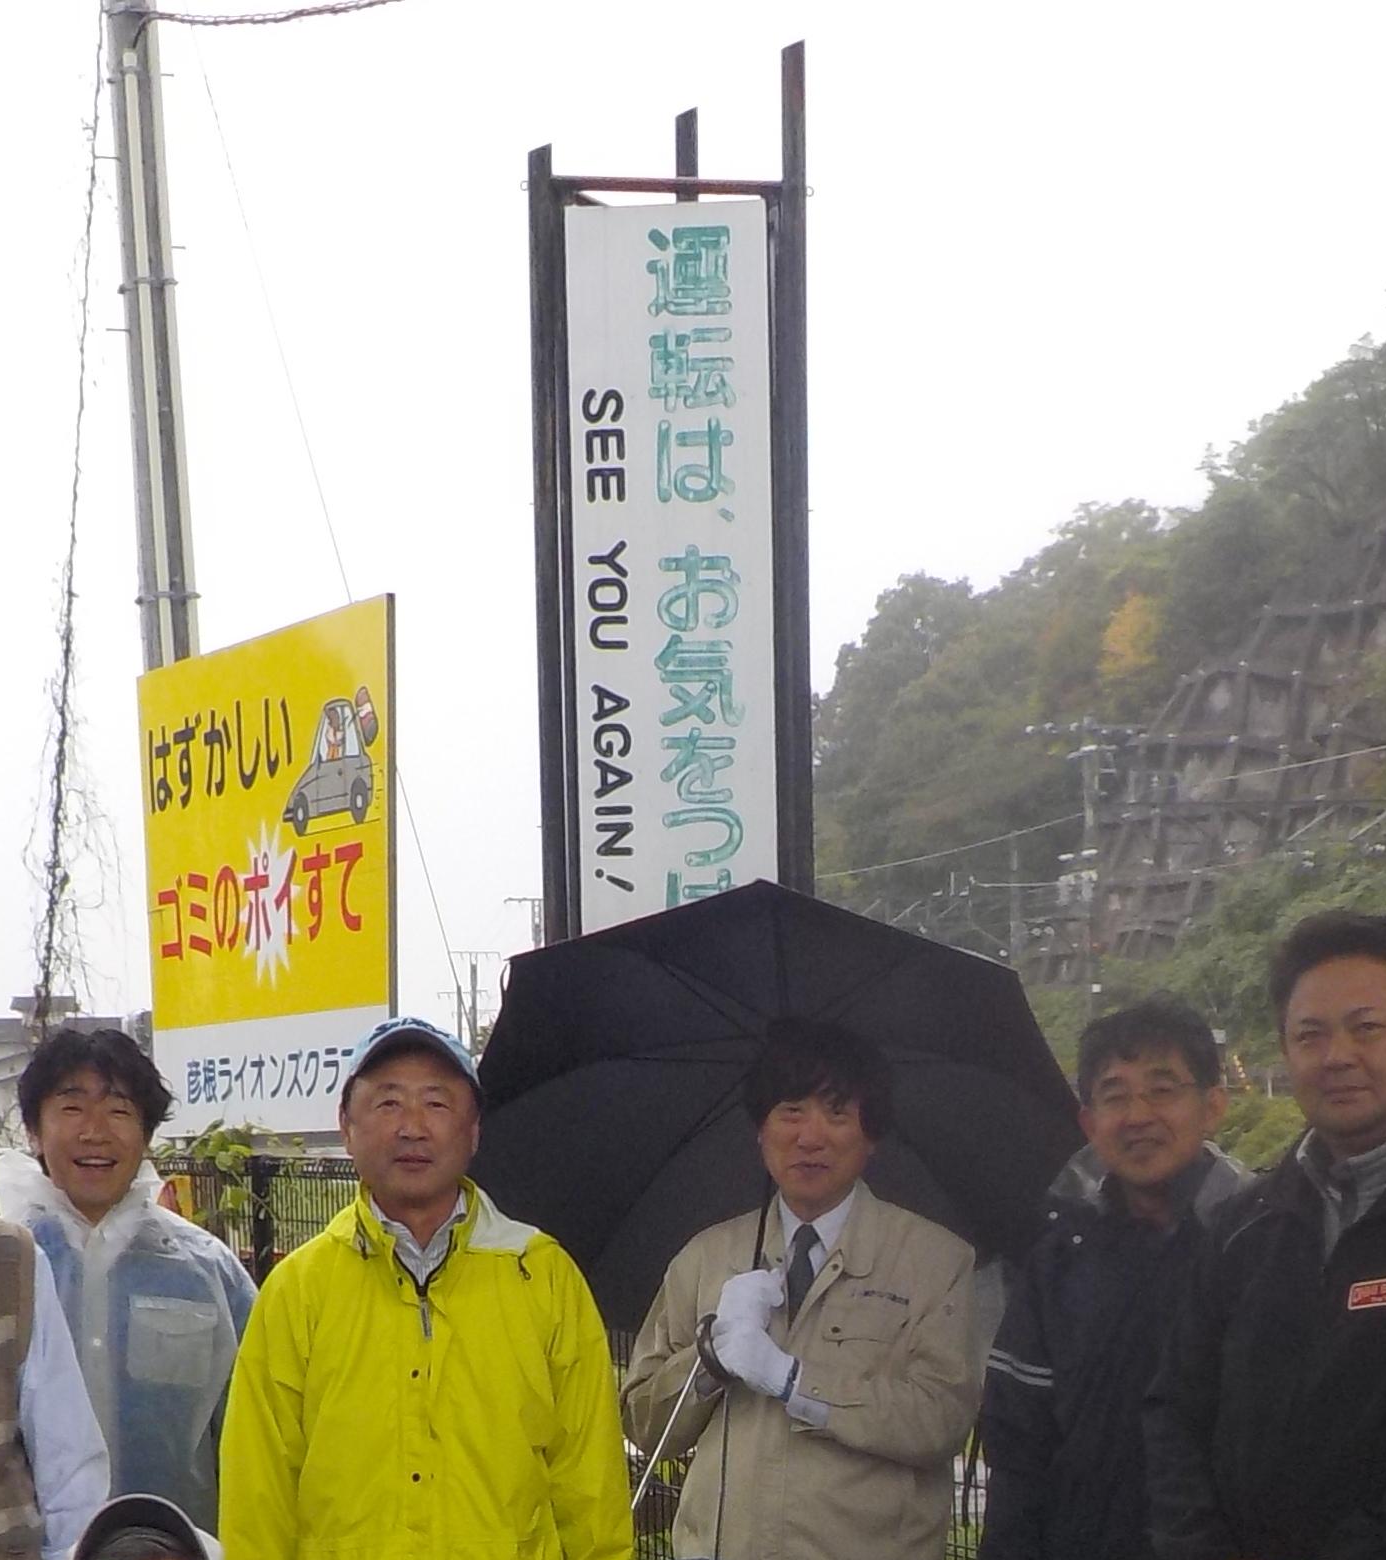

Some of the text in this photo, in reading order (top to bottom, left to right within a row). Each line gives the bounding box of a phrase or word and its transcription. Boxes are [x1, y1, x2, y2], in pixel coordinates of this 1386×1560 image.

[581, 388, 635, 893] SEE YOU AGAIN!
[148, 697, 292, 815] はずかしい
[158, 842, 363, 961] ゴミのポイすて
[186, 1047, 355, 1105] 彦根ライオンズクラ
